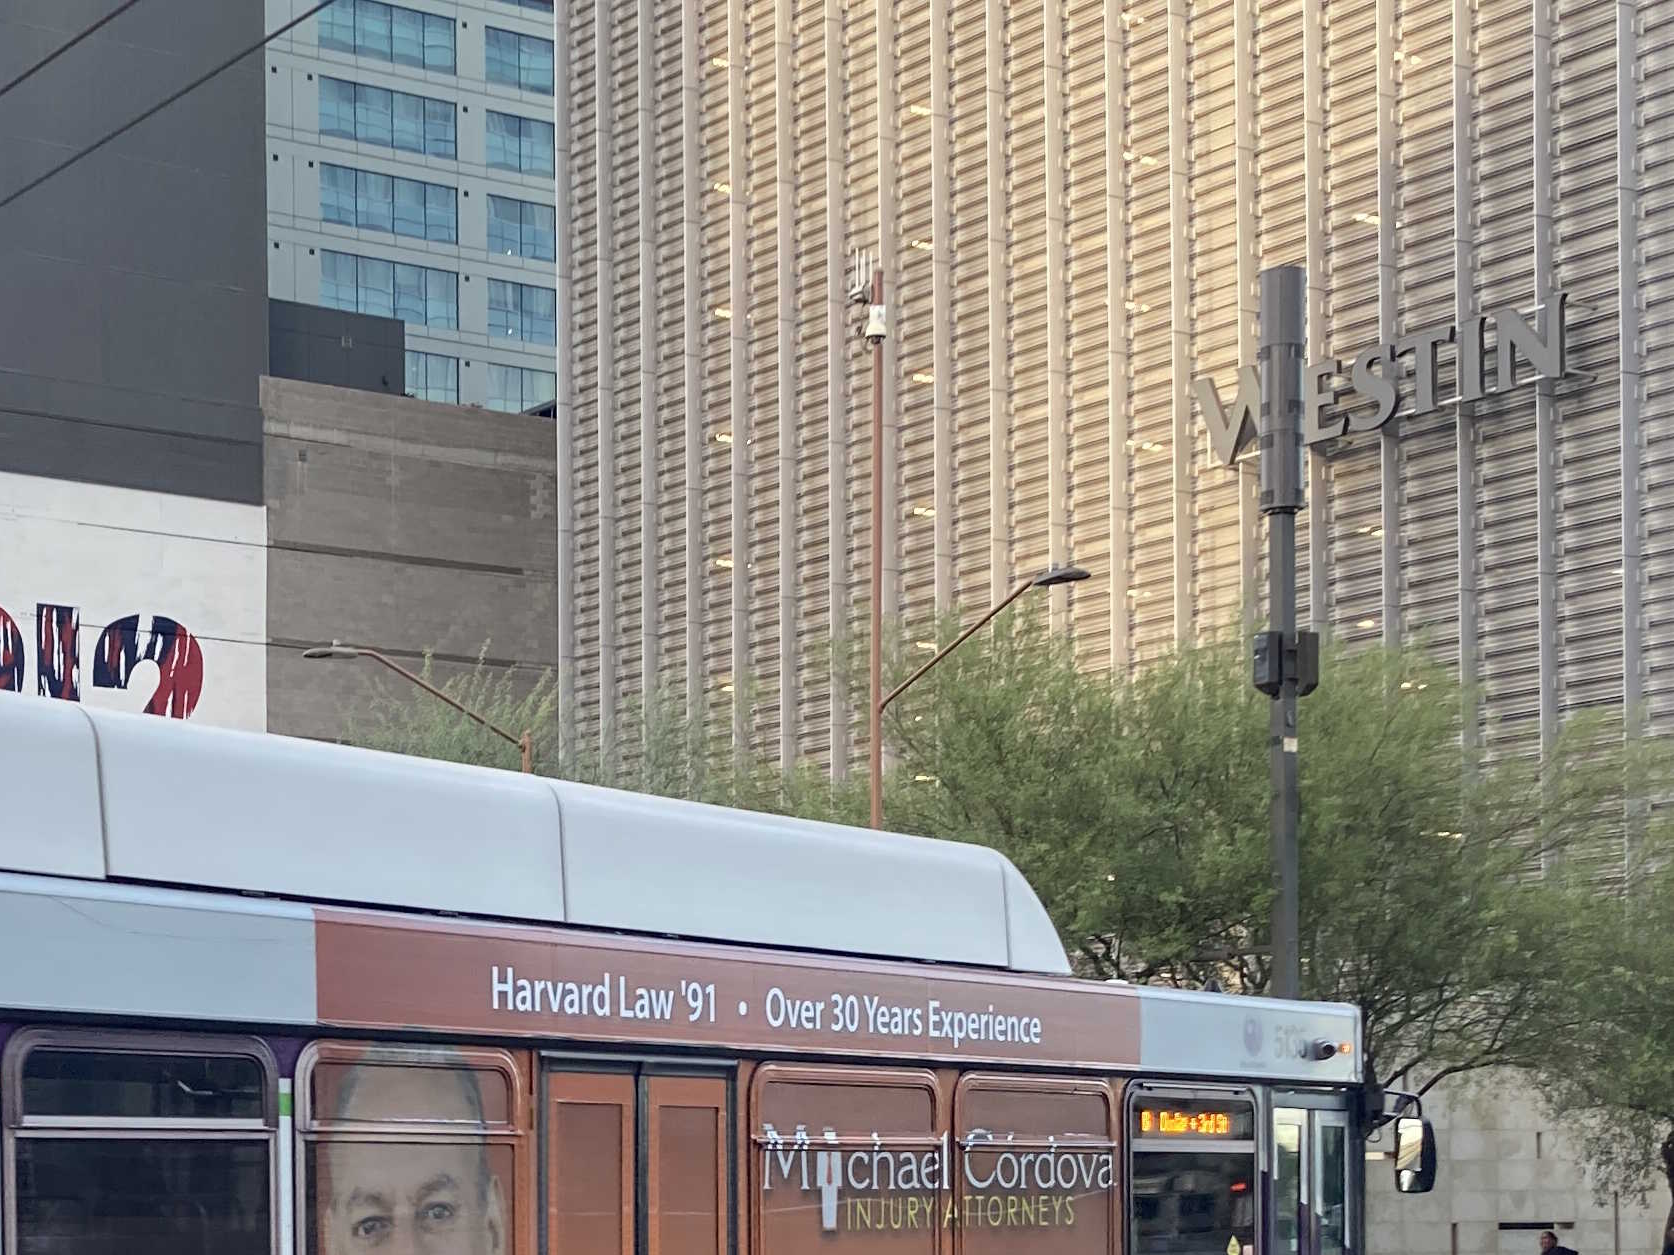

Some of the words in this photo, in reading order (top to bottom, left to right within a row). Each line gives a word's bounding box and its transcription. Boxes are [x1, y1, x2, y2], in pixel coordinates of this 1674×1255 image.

[1195, 292, 1567, 467] WESTIN
[491, 965, 611, 1017] Harvard
[619, 974, 673, 1021] Law
[681, 980, 717, 1023] '91
[765, 986, 824, 1031] Over
[830, 994, 860, 1033] 30
[863, 995, 923, 1038] Years
[928, 999, 1042, 1048] Experience
[964, 1128, 1114, 1189] Cordova
[846, 1195, 935, 1233] INJURY
[943, 1194, 1076, 1231] ATTORNEYS
